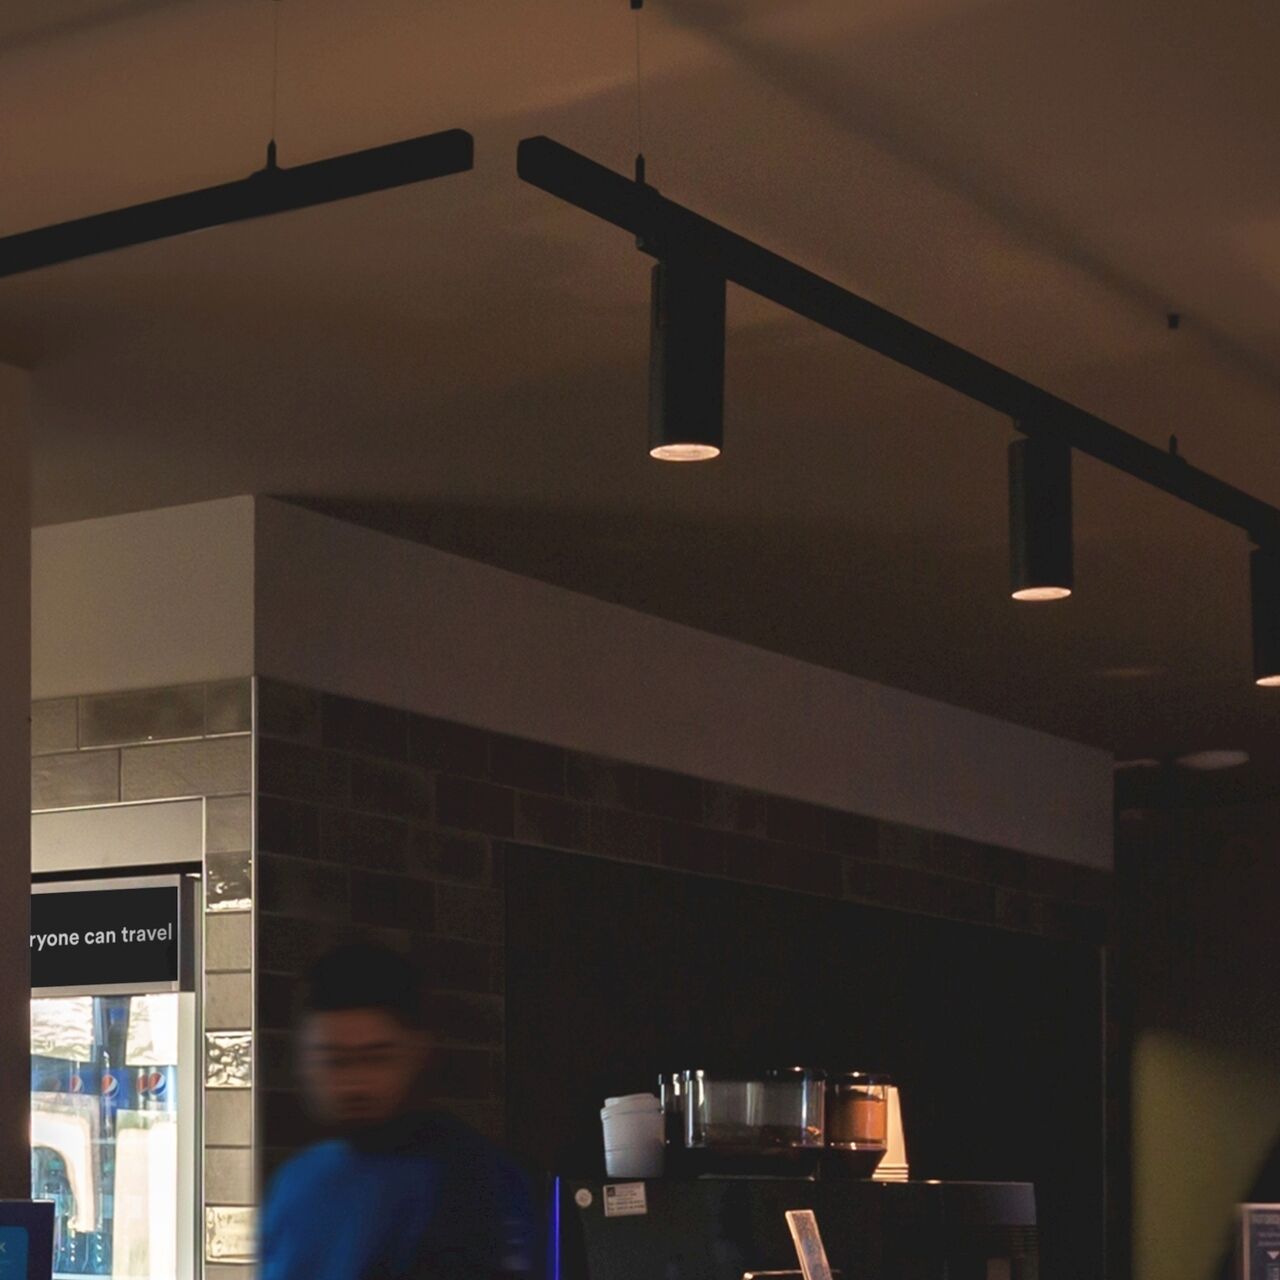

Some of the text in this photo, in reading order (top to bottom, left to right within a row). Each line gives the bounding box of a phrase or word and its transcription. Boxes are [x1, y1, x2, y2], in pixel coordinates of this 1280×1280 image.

[29, 922, 172, 952] ryone can travel
